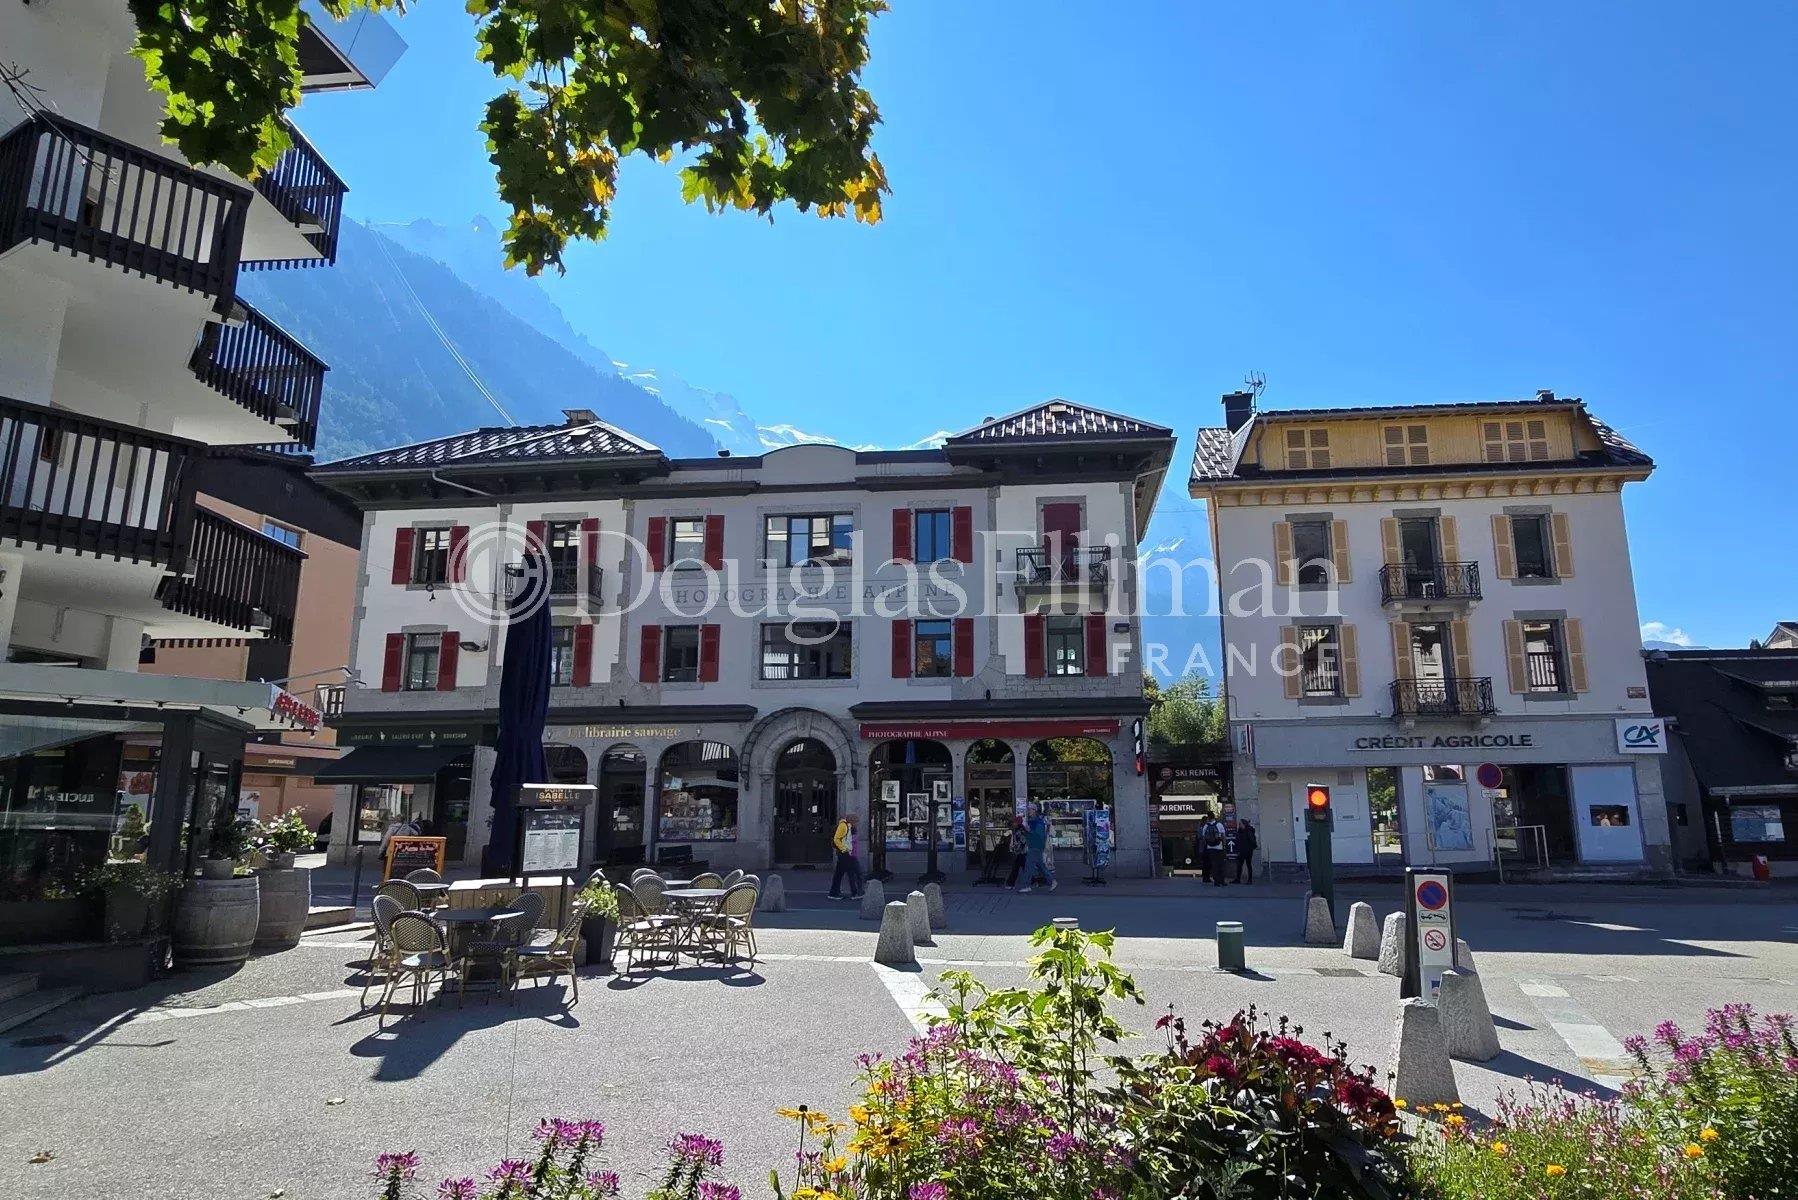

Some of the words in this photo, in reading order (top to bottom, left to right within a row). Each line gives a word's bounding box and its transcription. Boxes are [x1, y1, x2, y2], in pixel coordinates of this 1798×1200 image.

[660, 585, 847, 605] PHOTOGRAPHIE
[863, 583, 958, 600] ALPINE
[585, 726, 631, 738] librairie
[634, 727, 681, 740] sauvage
[1354, 734, 1426, 749] CRÉDIT
[1431, 734, 1533, 748] AGRICOLE
[1189, 768, 1219, 777] RENTAL
[535, 792, 581, 800] ISABELLE
